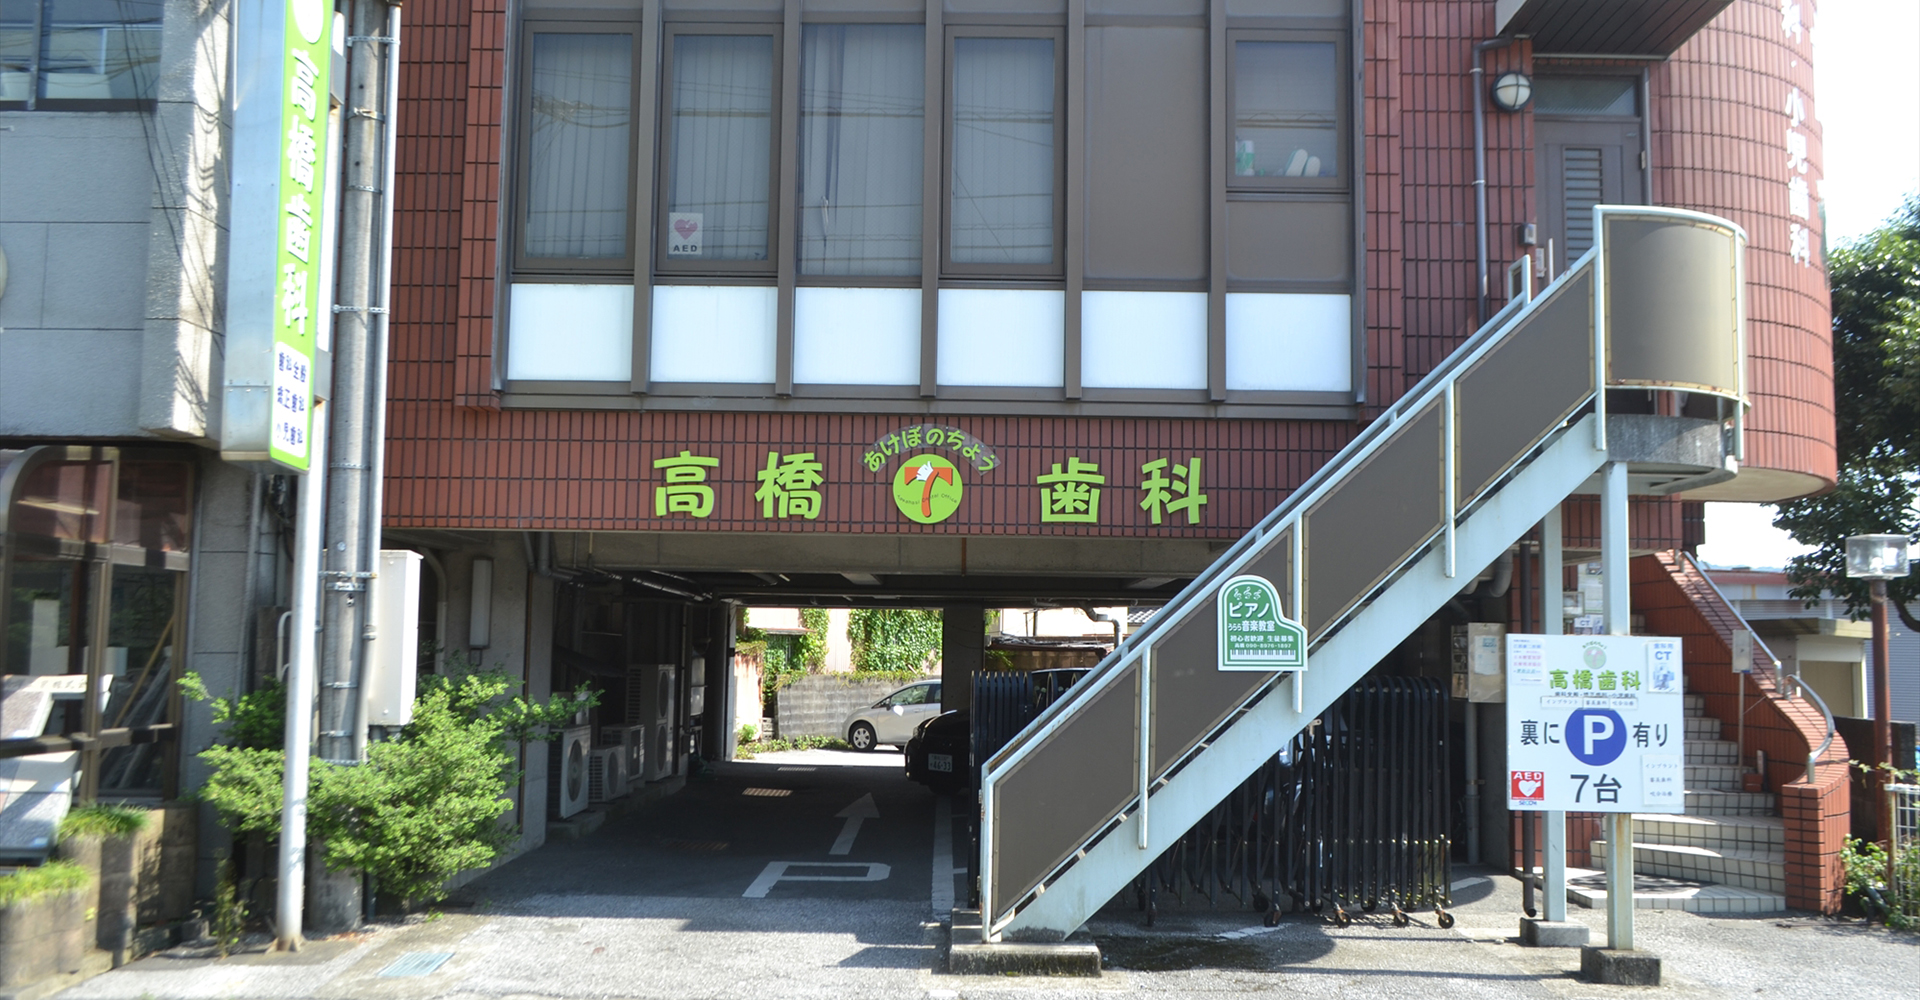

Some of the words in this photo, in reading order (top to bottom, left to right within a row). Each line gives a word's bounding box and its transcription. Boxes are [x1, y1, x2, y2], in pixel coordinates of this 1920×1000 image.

[282, 48, 319, 336] 高橋歯科
[673, 244, 698, 253] AED
[863, 425, 996, 473] あけぼのちょう
[1229, 602, 1270, 618] ピアノ
[1655, 651, 1672, 660] CT
[1548, 668, 1642, 691] 高橋歯科
[1520, 718, 1561, 746] 裏に
[1583, 714, 1615, 756] P
[1632, 721, 1669, 748] 有り
[1512, 771, 1542, 780] AED
[1569, 773, 1623, 804] 7台
